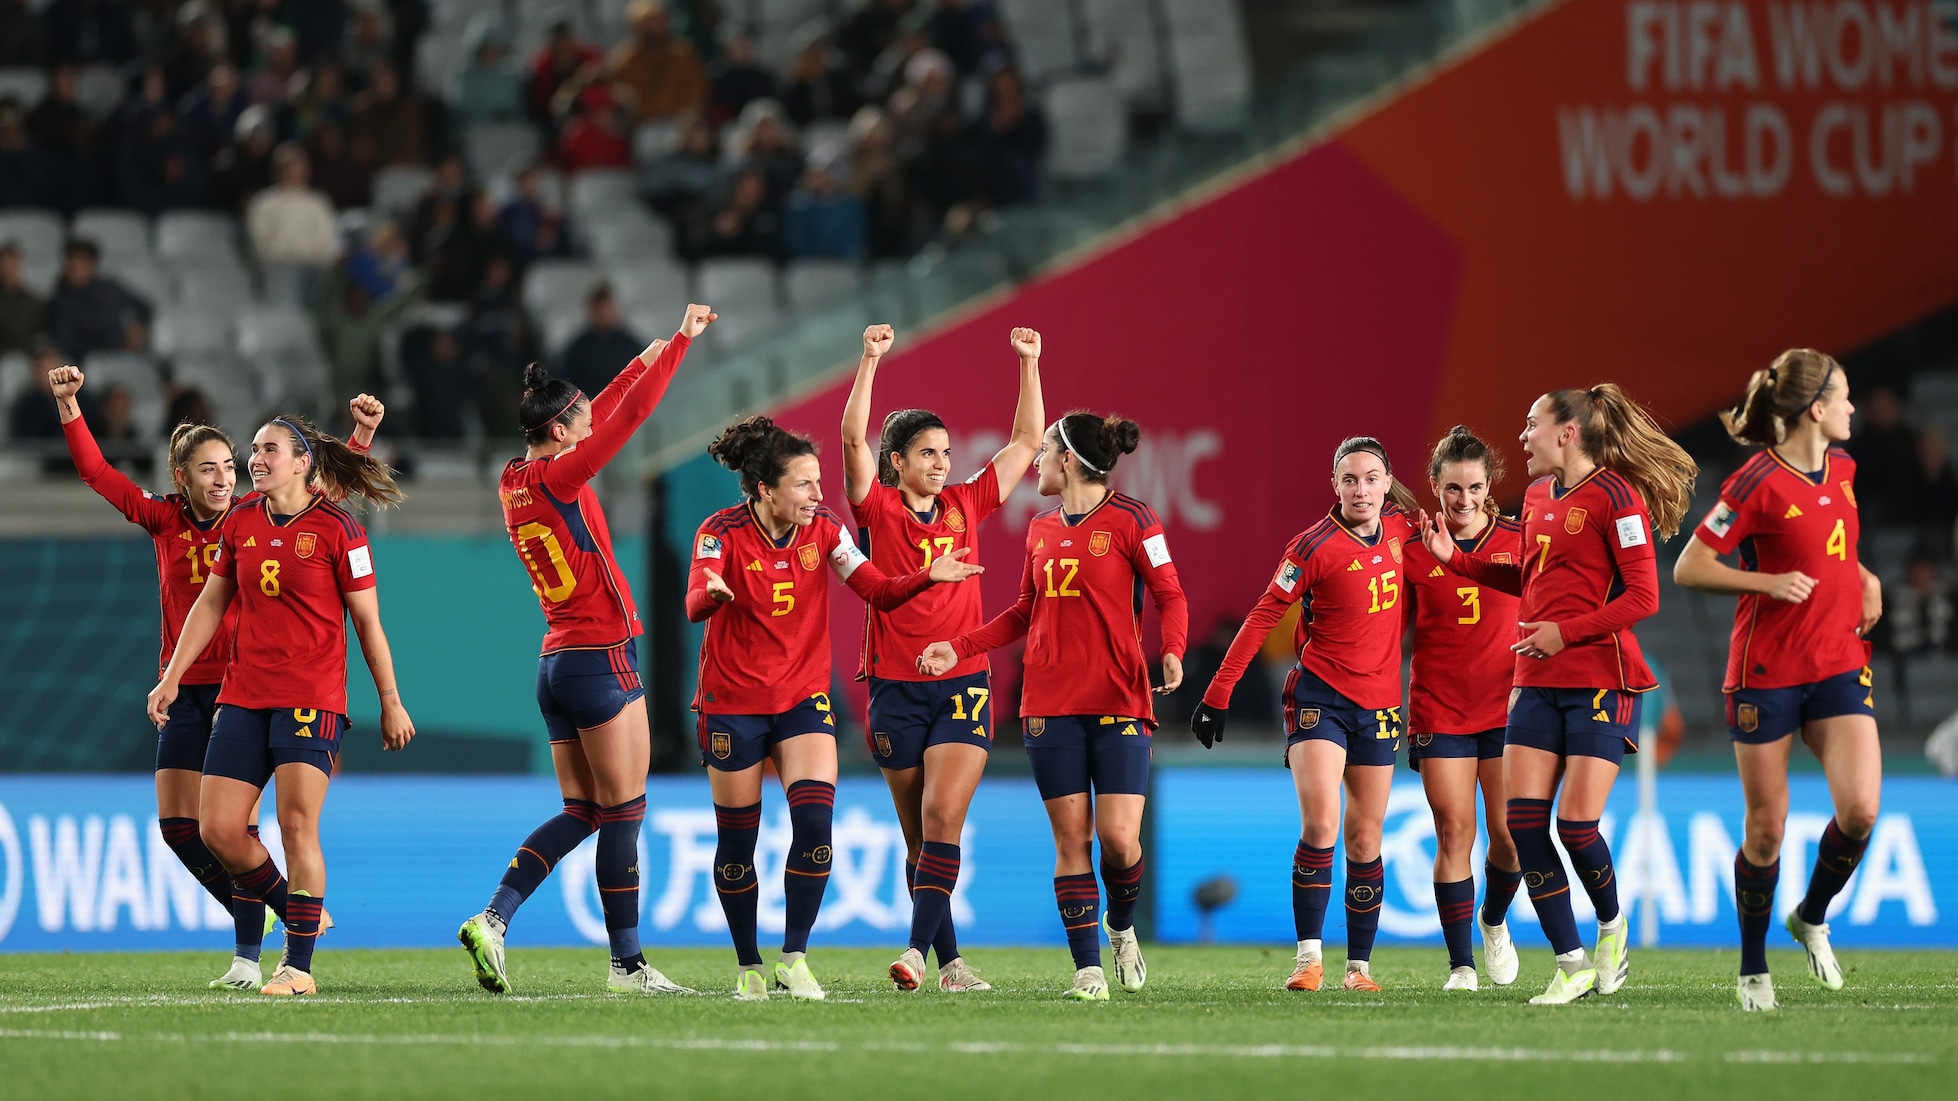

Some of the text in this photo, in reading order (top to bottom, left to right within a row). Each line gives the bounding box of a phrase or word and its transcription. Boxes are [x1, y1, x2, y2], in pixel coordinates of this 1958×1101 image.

[1626, 0, 1761, 92] FIFA
[1557, 101, 1944, 202] WORLD CUP
[918, 536, 955, 570] 17
[1536, 533, 1552, 573] 7
[1827, 518, 1847, 562] 4
[260, 559, 281, 596] 8
[507, 521, 578, 603] 0
[1043, 558, 1080, 598] 12
[771, 581, 795, 617] 5
[1367, 569, 1399, 614] 15
[1456, 586, 1481, 625] 3
[951, 686, 990, 722] 17
